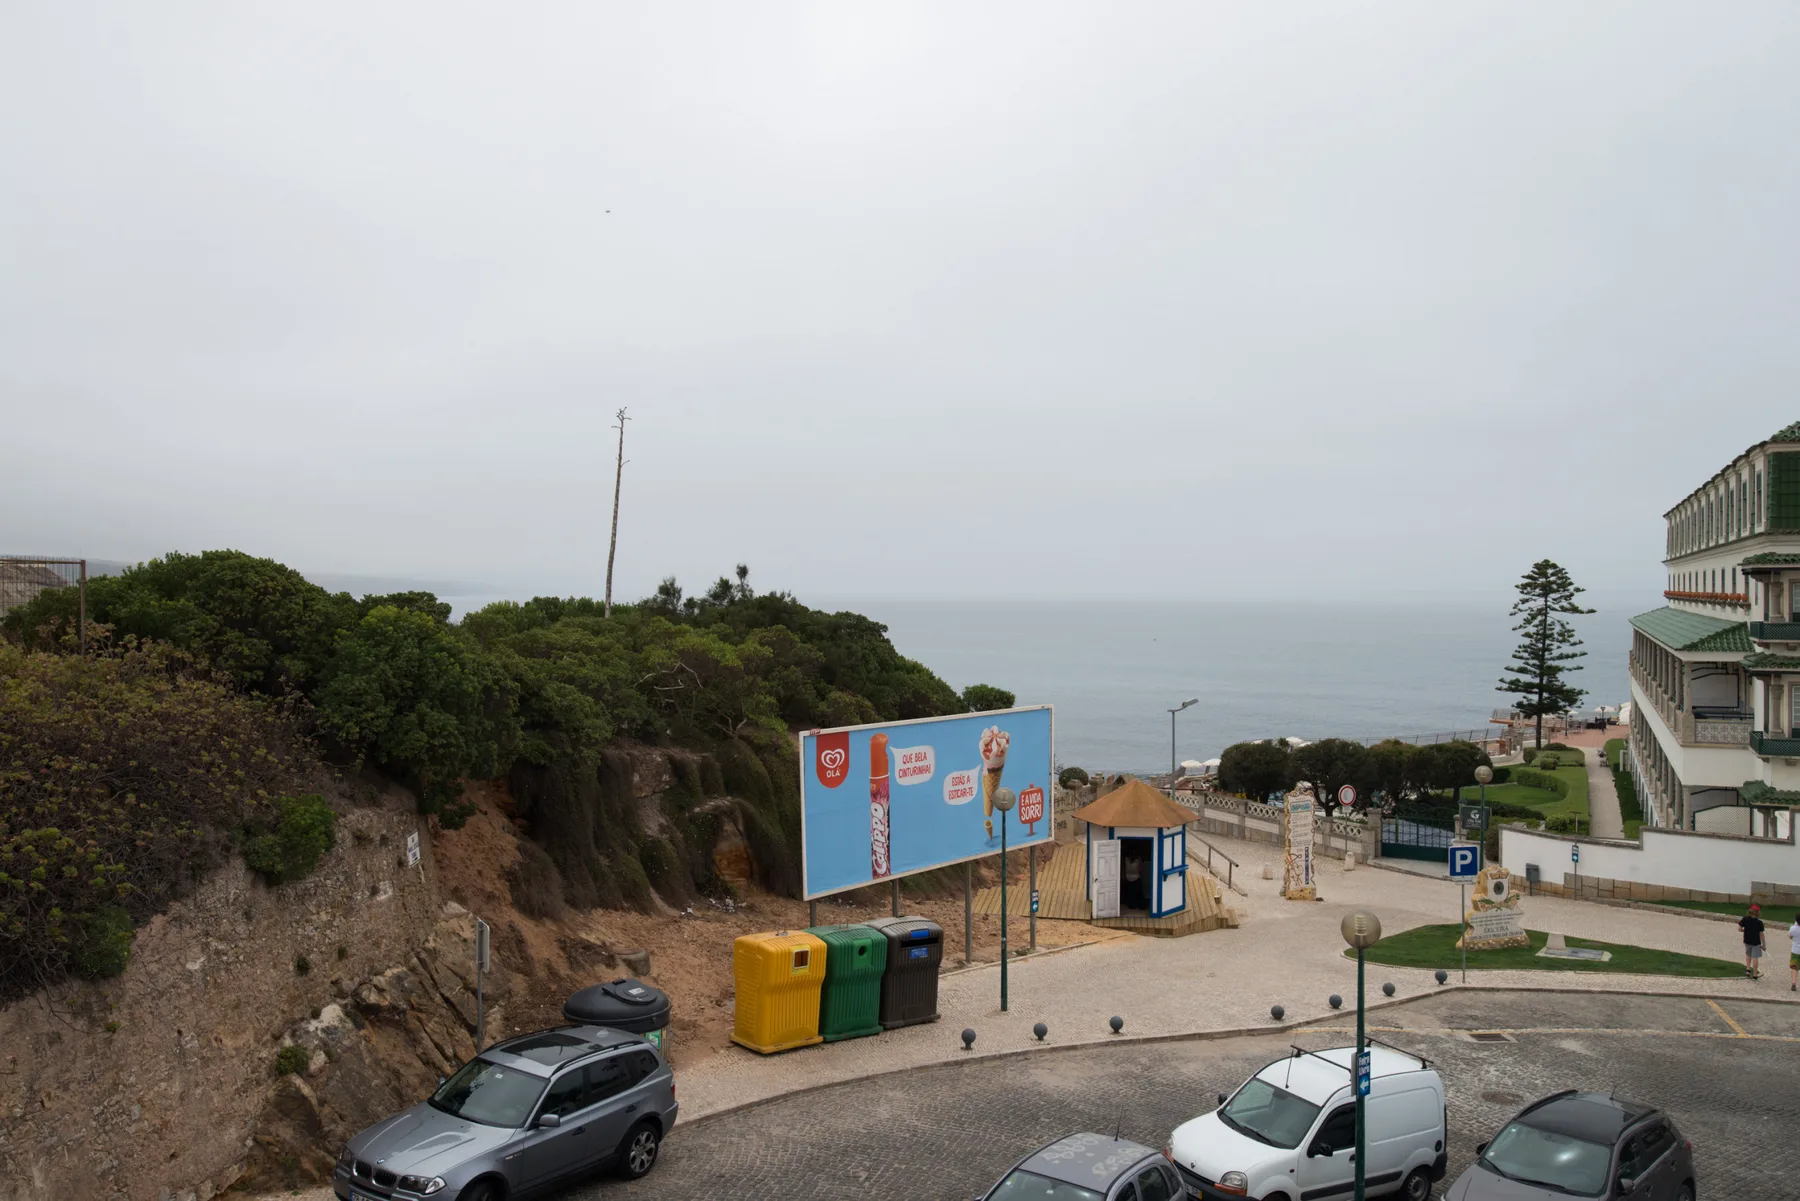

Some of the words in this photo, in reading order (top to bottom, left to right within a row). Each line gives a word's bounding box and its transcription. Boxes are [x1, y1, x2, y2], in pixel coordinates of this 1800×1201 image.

[902, 754, 913, 765] QUE
[915, 752, 927, 762] BELA
[826, 767, 840, 778] OLÁ
[898, 764, 931, 779] CINTURINHA!
[951, 774, 965, 787] ESTÁS
[966, 774, 971, 785] A
[948, 787, 974, 800] ESTICAR-TE
[1021, 794, 1025, 807] E
[1029, 792, 1042, 804] VIDA
[1021, 804, 1042, 821] SORRI
[1455, 850, 1473, 873] P
